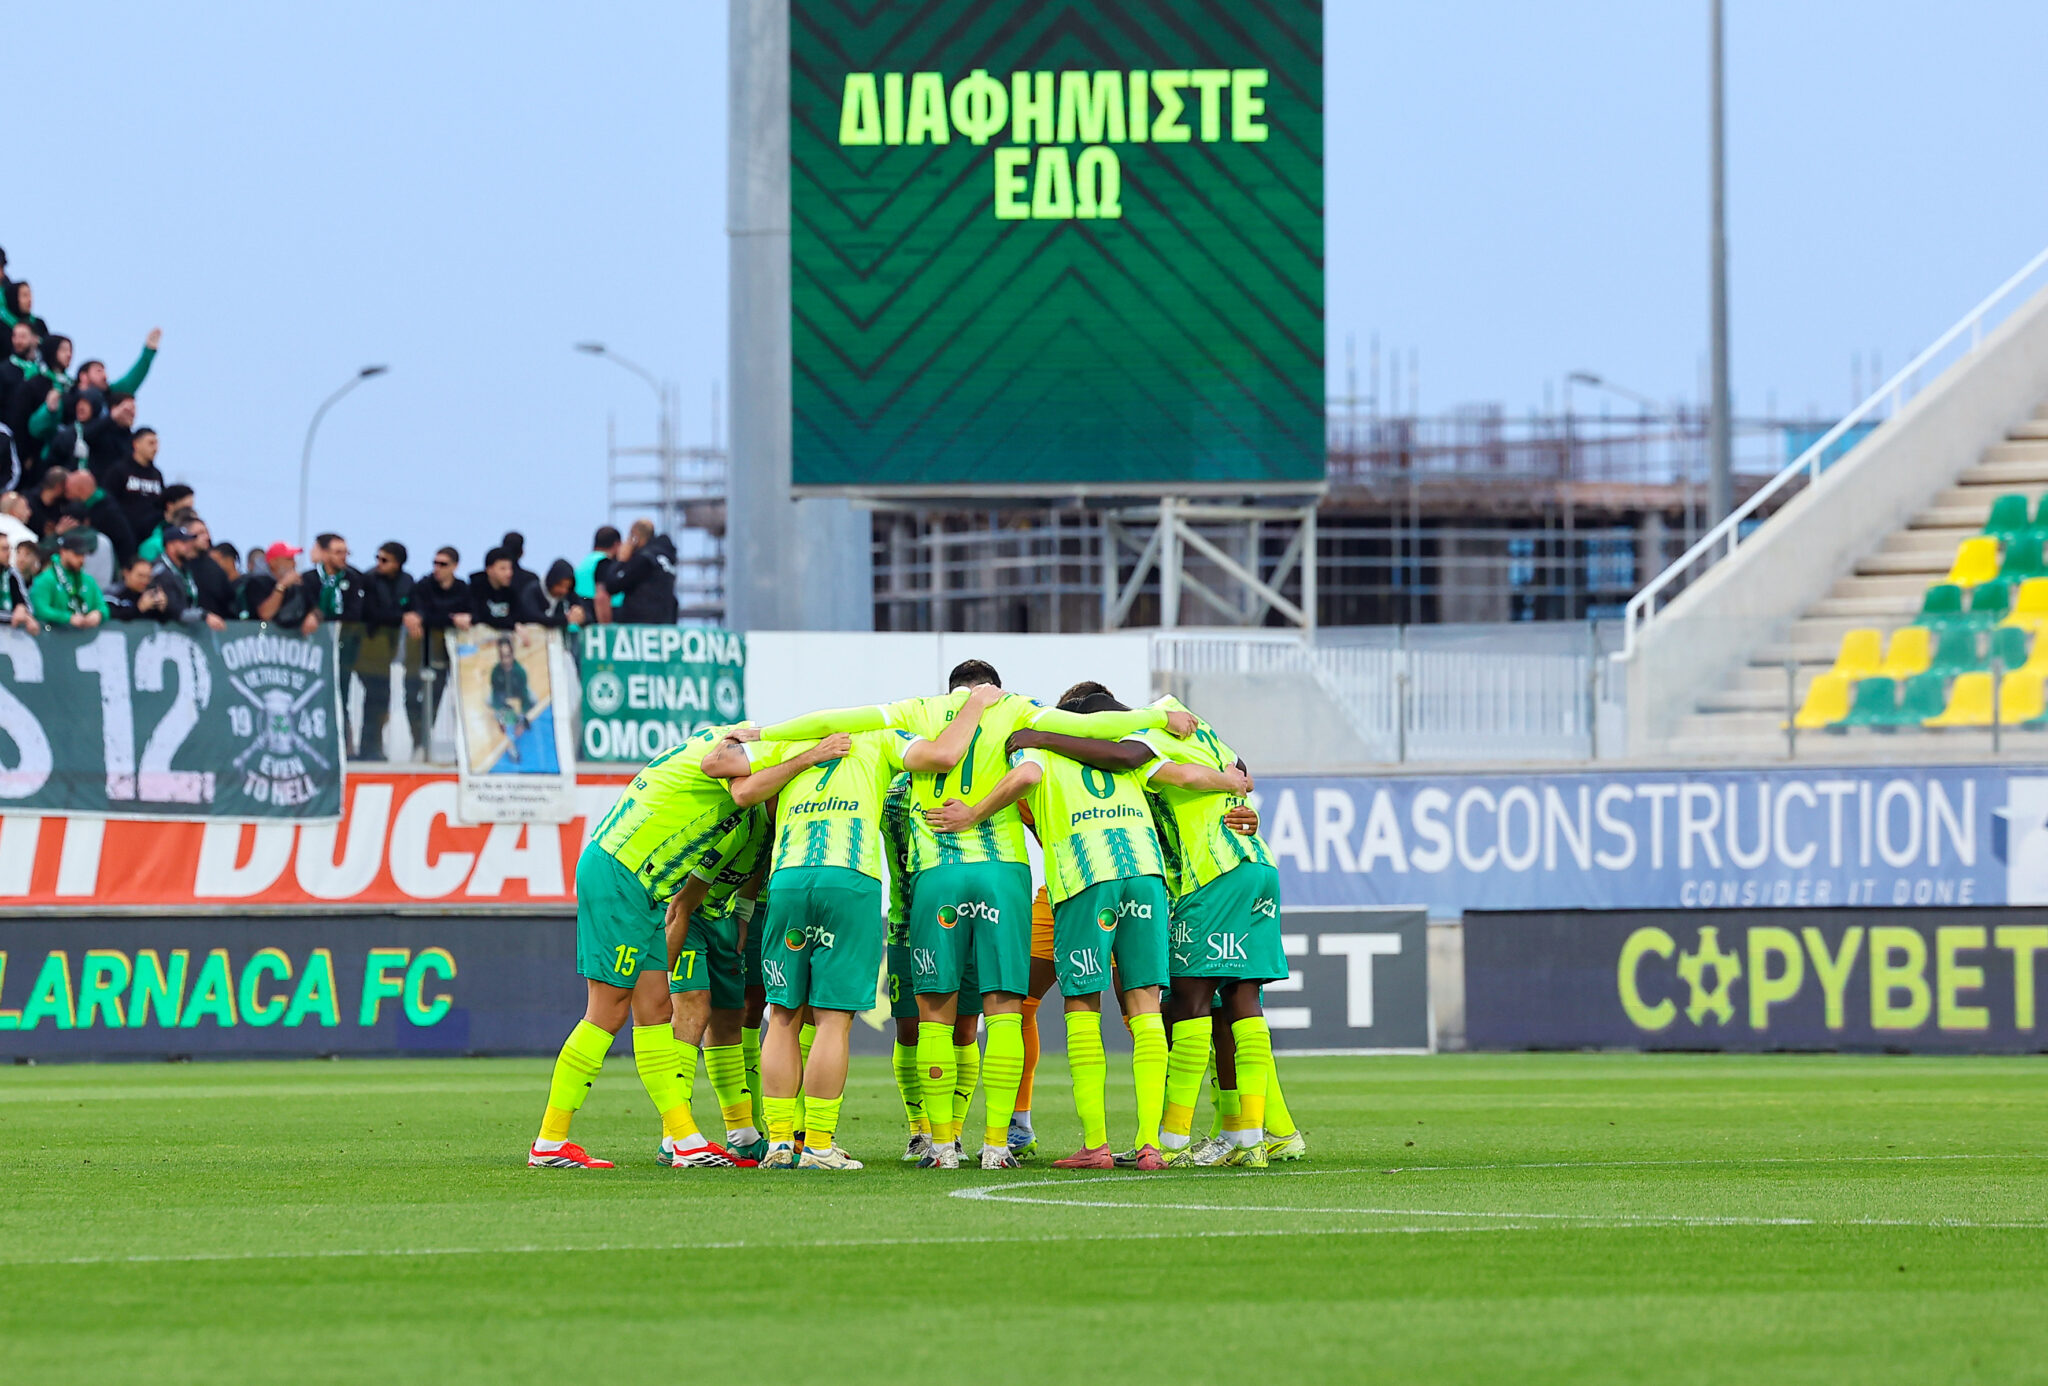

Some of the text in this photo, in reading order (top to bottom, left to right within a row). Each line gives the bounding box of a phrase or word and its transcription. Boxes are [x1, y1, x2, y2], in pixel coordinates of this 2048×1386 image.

[838, 69, 1268, 145] ΔΙΑΦΗΜΙΣΤΕ
[994, 145, 1122, 220] ΕΔΩ
[221, 634, 323, 675] OMONOIA
[612, 626, 744, 667] ΔΙΕΡΩΝΑ
[628, 674, 710, 711] ΕΙΝΑΙ
[76, 630, 215, 803] 12
[227, 705, 327, 739] 19 48
[584, 718, 713, 759] ΟΜΟΝ
[259, 754, 305, 779] EVEN
[243, 770, 320, 806] TO HELL
[1072, 804, 1143, 826] petrolina
[1250, 779, 1977, 873] ARASCONSTRUCTION
[1116, 900, 1152, 919] yta
[1680, 878, 1976, 907] CONSIDER IT DONE
[958, 902, 1000, 924] cyta
[615, 944, 638, 976] 15
[1206, 932, 1249, 960] SLK
[359, 947, 457, 1027] FC
[888, 973, 900, 1003] 3
